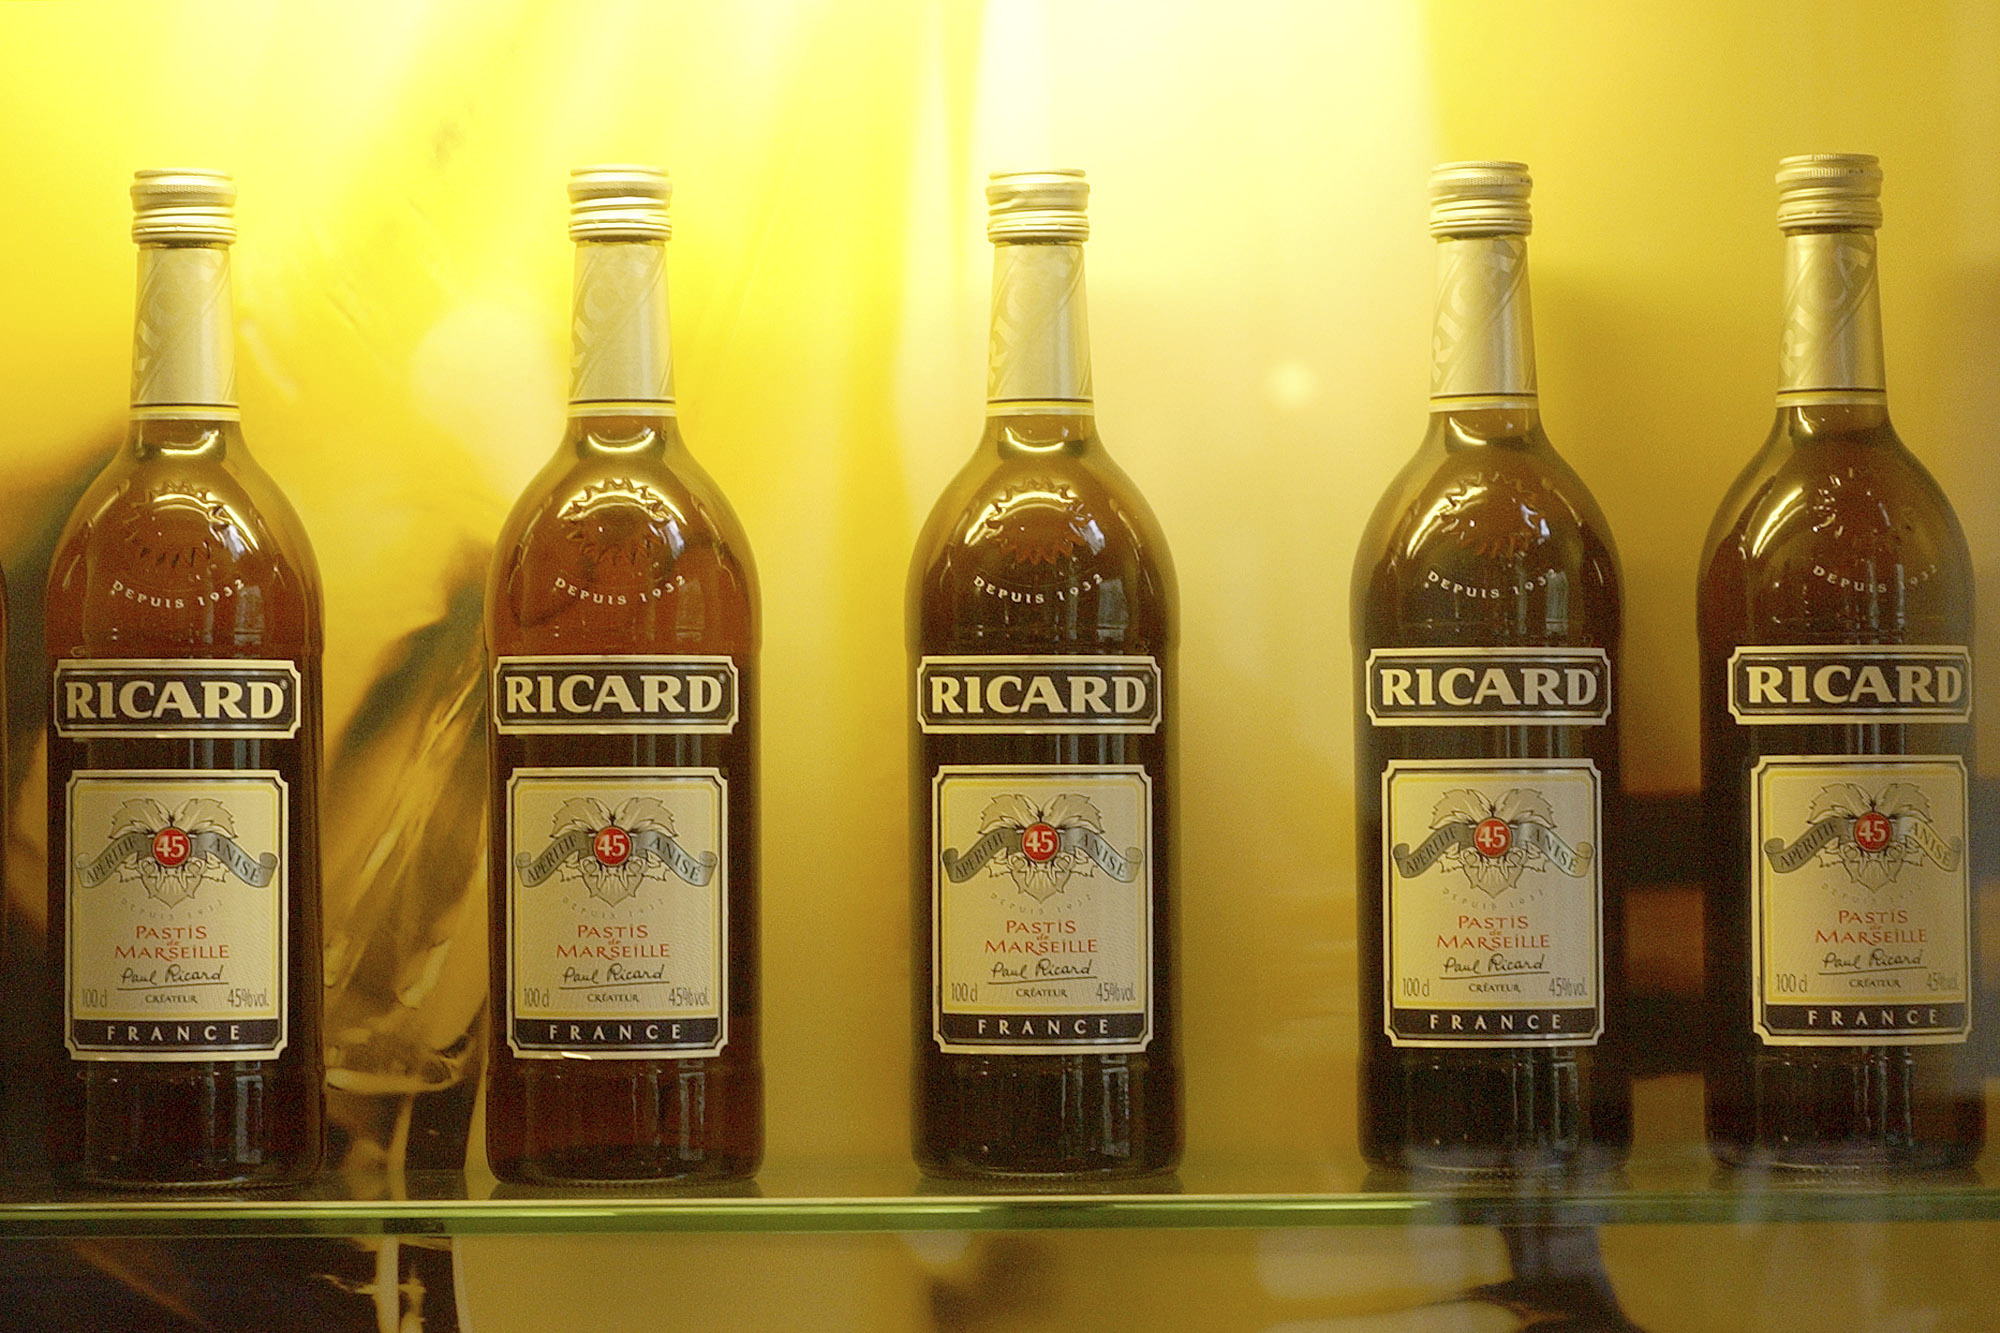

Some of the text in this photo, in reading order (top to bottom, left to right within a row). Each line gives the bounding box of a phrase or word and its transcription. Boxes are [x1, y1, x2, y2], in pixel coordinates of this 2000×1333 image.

[555, 575, 685, 605] DEPUIS 1932
[973, 575, 1044, 604] DEPUIS
[1427, 570, 1500, 598] DEPUIS
[1813, 565, 1887, 594] DEPUIS
[112, 579, 244, 609] DEPUIS 1932
[505, 675, 722, 713] RICARD
[930, 675, 1146, 713] RICARD
[1380, 667, 1598, 706] RICARD
[1746, 665, 1962, 704] RICARD
[65, 681, 284, 719] RICARD
[1478, 826, 1506, 848] 45
[1858, 819, 1887, 842] 45
[155, 836, 185, 857] 45
[597, 834, 625, 856] 45
[1025, 831, 1054, 852] 45
[1006, 920, 1077, 933] PASTIS
[1458, 915, 1529, 929] PASTIS
[1838, 910, 1908, 924] PASTIS
[136, 925, 207, 939] PASTIS
[577, 925, 648, 938] PASTIS
[1489, 928, 1502, 936] de
[1815, 928, 1928, 946] MARSEILLE
[114, 945, 230, 961] MARSEILLE
[557, 944, 669, 960] MARSEILLE
[985, 939, 1097, 956] MARSEILLE
[1437, 934, 1550, 951] MARSEILLE
[990, 958, 1092, 979] Paul Ricard
[1443, 953, 1545, 974] Paul Ricard
[1822, 948, 1923, 969] Paul Ricard
[120, 963, 224, 985] Paul Ricard
[562, 963, 664, 984] Paul Ricard
[978, 1019, 1109, 1035] FRANCE
[1429, 1014, 1561, 1030] FRANCE
[1808, 1009, 1937, 1026] FRANCE
[107, 1025, 240, 1041] FRANCE
[549, 1024, 681, 1040] FRANCE
